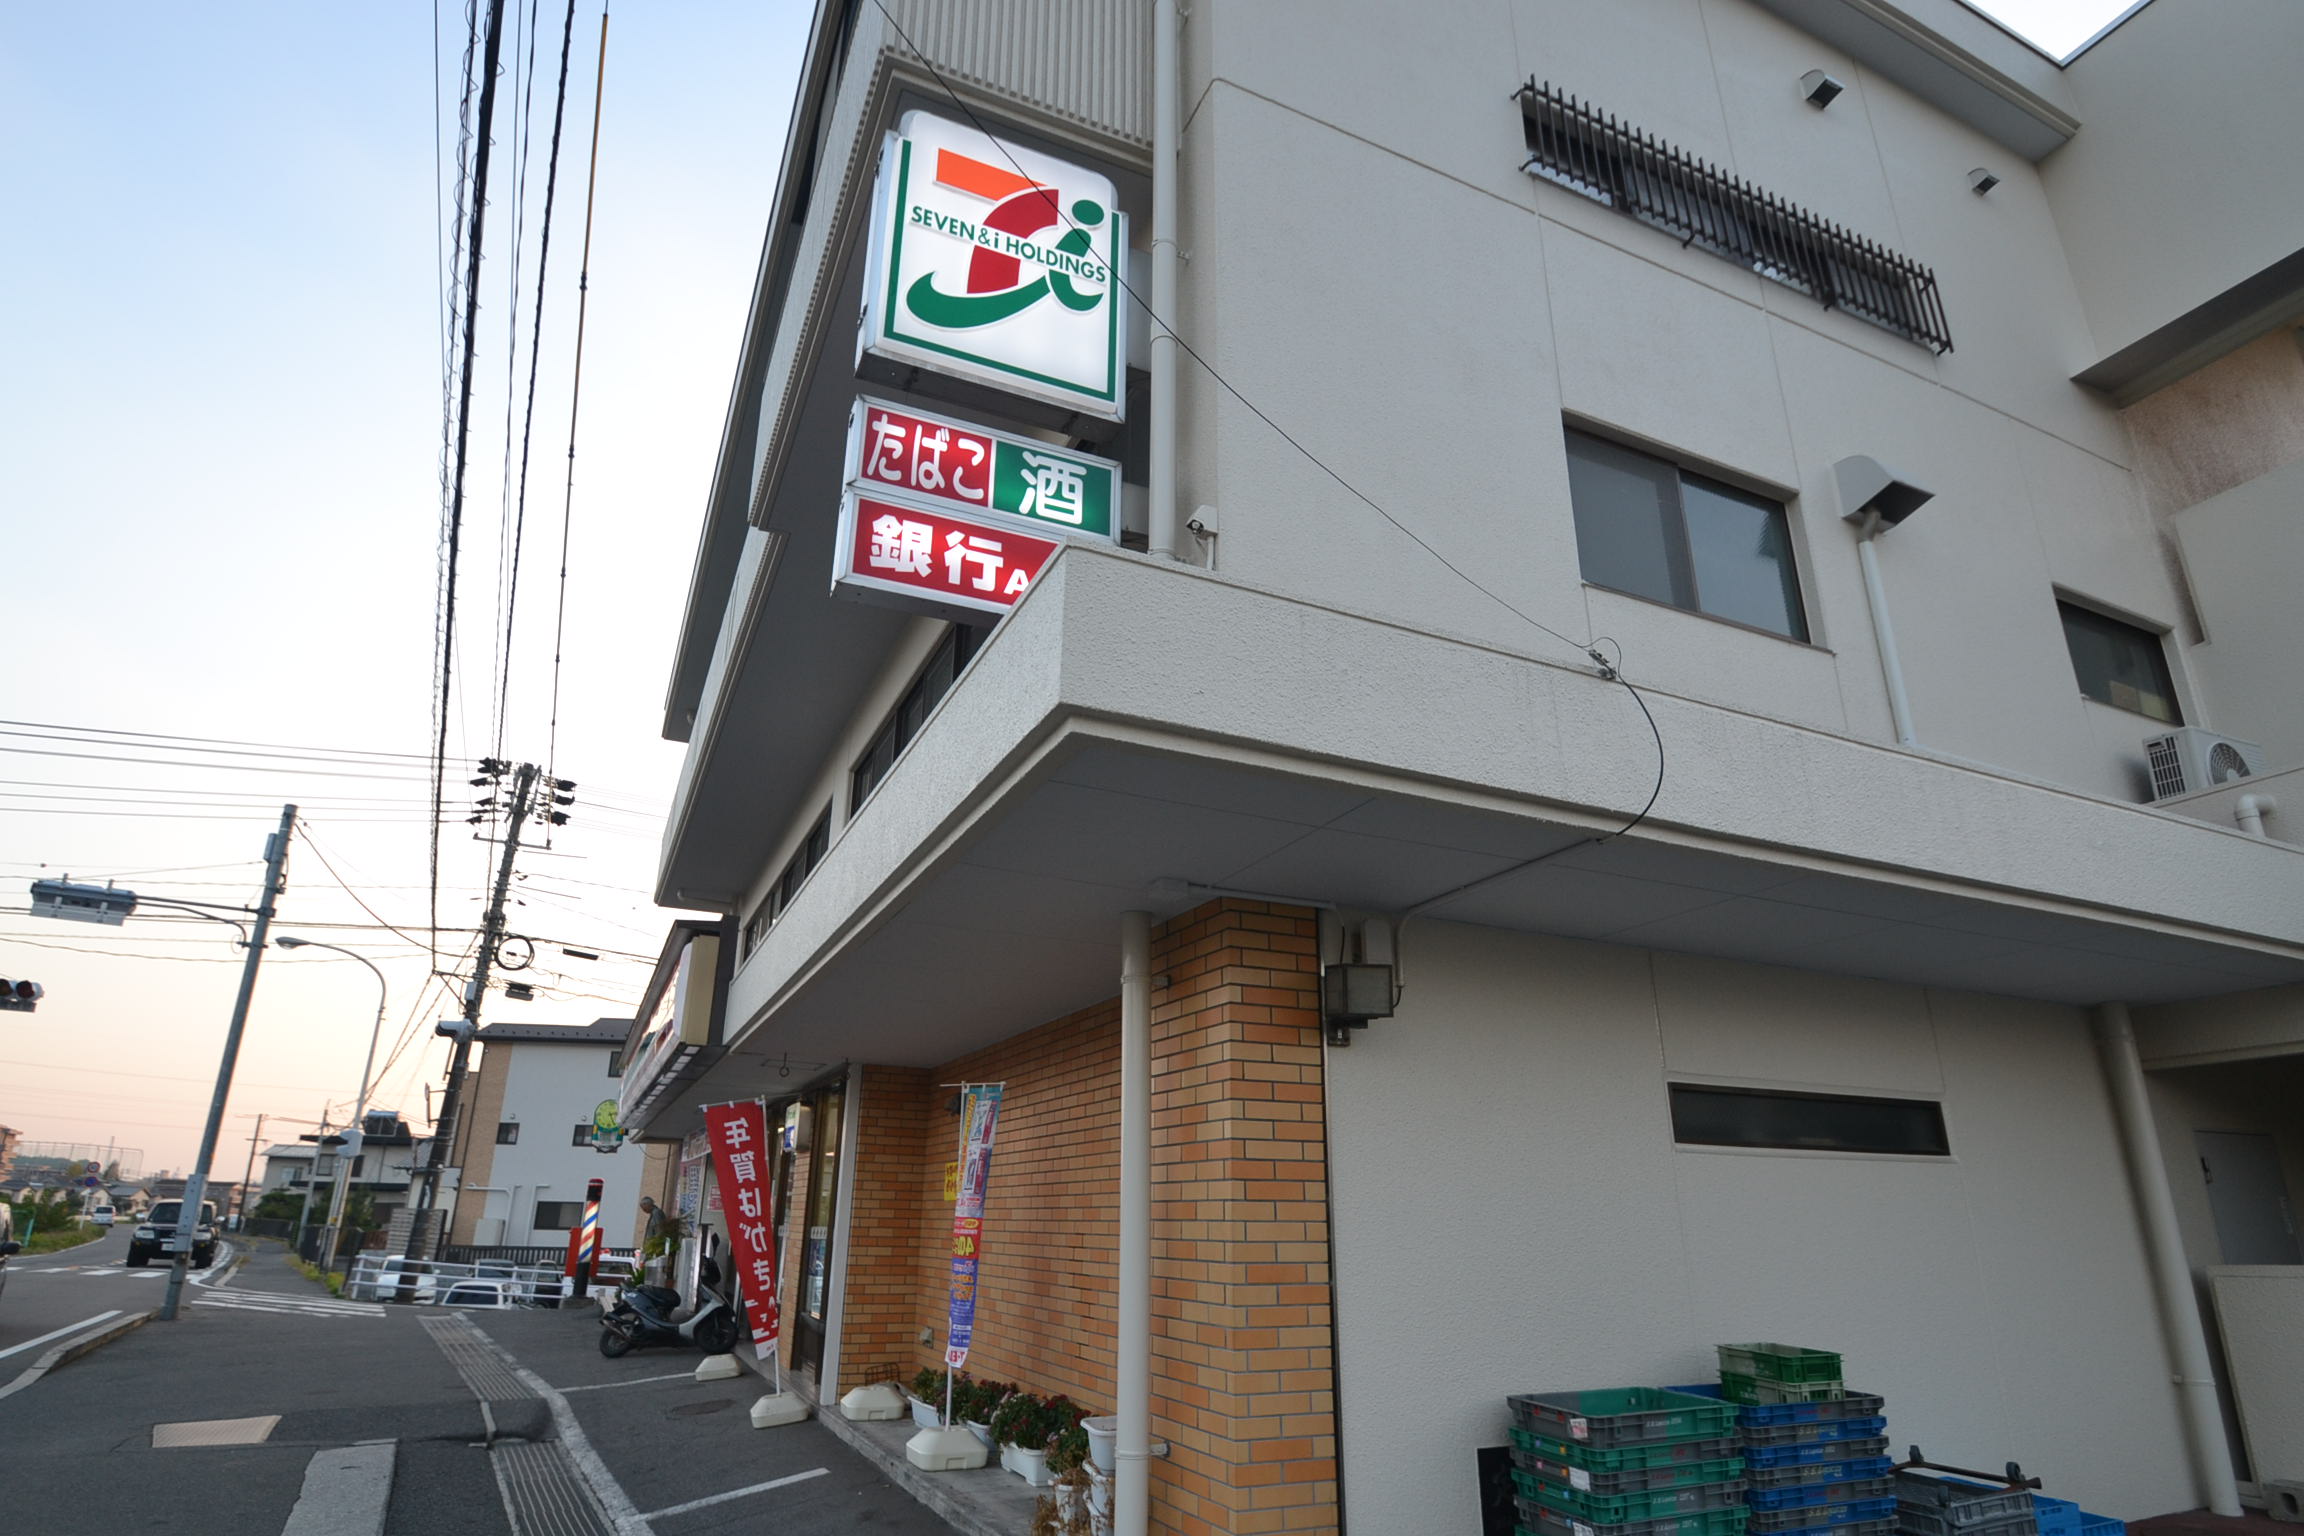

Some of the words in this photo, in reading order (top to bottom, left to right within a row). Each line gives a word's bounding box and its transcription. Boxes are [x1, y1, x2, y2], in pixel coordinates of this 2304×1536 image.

[1006, 236, 1107, 283] HOLDINGS
[867, 413, 985, 500] たばこ
[1018, 450, 1087, 525] 酒
